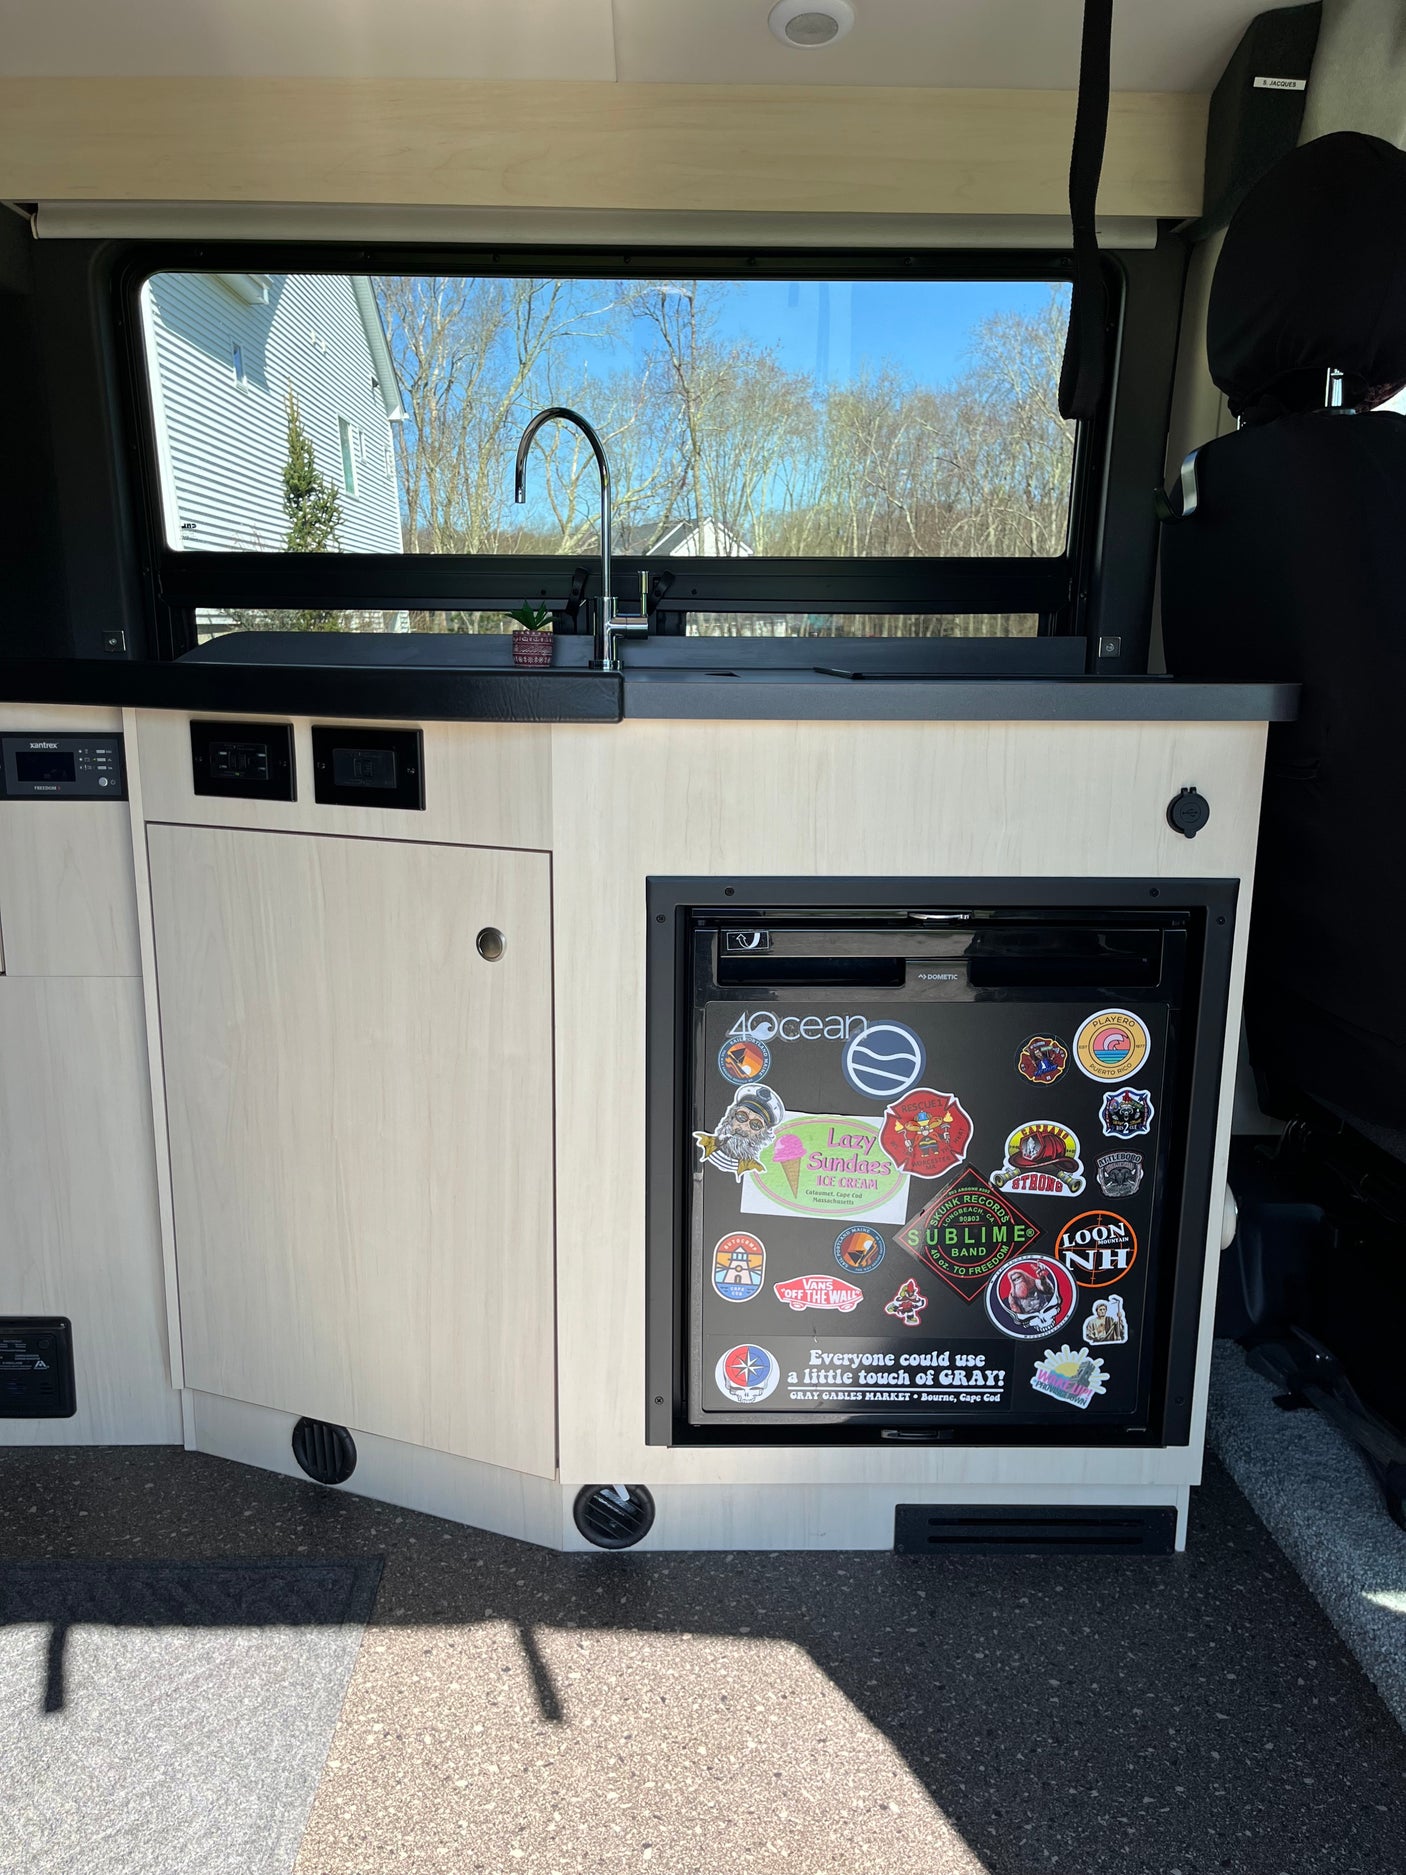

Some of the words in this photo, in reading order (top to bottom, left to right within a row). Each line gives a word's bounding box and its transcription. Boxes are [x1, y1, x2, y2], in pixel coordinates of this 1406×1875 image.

[1269, 80, 1297, 88] JACQUES
[1092, 1016, 1136, 1028] PLAYERO
[1089, 1064, 1116, 1076] PUERTO
[1117, 1062, 1133, 1074] RICO
[826, 1127, 877, 1156] Lazy
[806, 1152, 892, 1176] Sundaes
[1098, 1153, 1141, 1167] ATTLEBORO
[816, 1175, 836, 1187] ICE
[838, 1176, 878, 1190] CREAM
[1012, 1173, 1064, 1193] STRONG
[812, 1197, 855, 1206] Massachusetts
[836, 1191, 851, 1199] Cape
[851, 1192, 863, 1200] Cod
[930, 1197, 961, 1226] SKUNK
[963, 1195, 1009, 1223] RECORDS
[1062, 1222, 1126, 1249] LOON
[1098, 1236, 1130, 1246] MOUNTAIN
[836, 1230, 851, 1257] PORTLAND
[951, 1246, 987, 1257] BAND
[930, 1248, 941, 1260] 40
[938, 1260, 951, 1271] OZ.
[953, 1265, 967, 1275] TO
[968, 1244, 1010, 1275] FREEDOM
[1062, 1248, 1131, 1271] NH
[802, 1278, 834, 1290] VANS
[805, 1289, 828, 1304] THE
[809, 1349, 895, 1369] Everyone
[899, 1351, 950, 1367] could
[955, 1354, 986, 1368] use
[787, 1371, 798, 1384] a
[803, 1368, 853, 1384] little
[858, 1369, 910, 1385] touch
[915, 1369, 935, 1385] of
[939, 1369, 1006, 1387] GRAY!
[1037, 1369, 1072, 1393] WAKE
[1071, 1382, 1094, 1401] UP!
[789, 1391, 820, 1400] GRAY
[822, 1391, 863, 1401] GABLES
[865, 1392, 911, 1401] MARKET
[920, 1393, 957, 1403] Bourne,
[959, 1393, 982, 1403] Cape
[983, 1393, 1001, 1402] Cod
